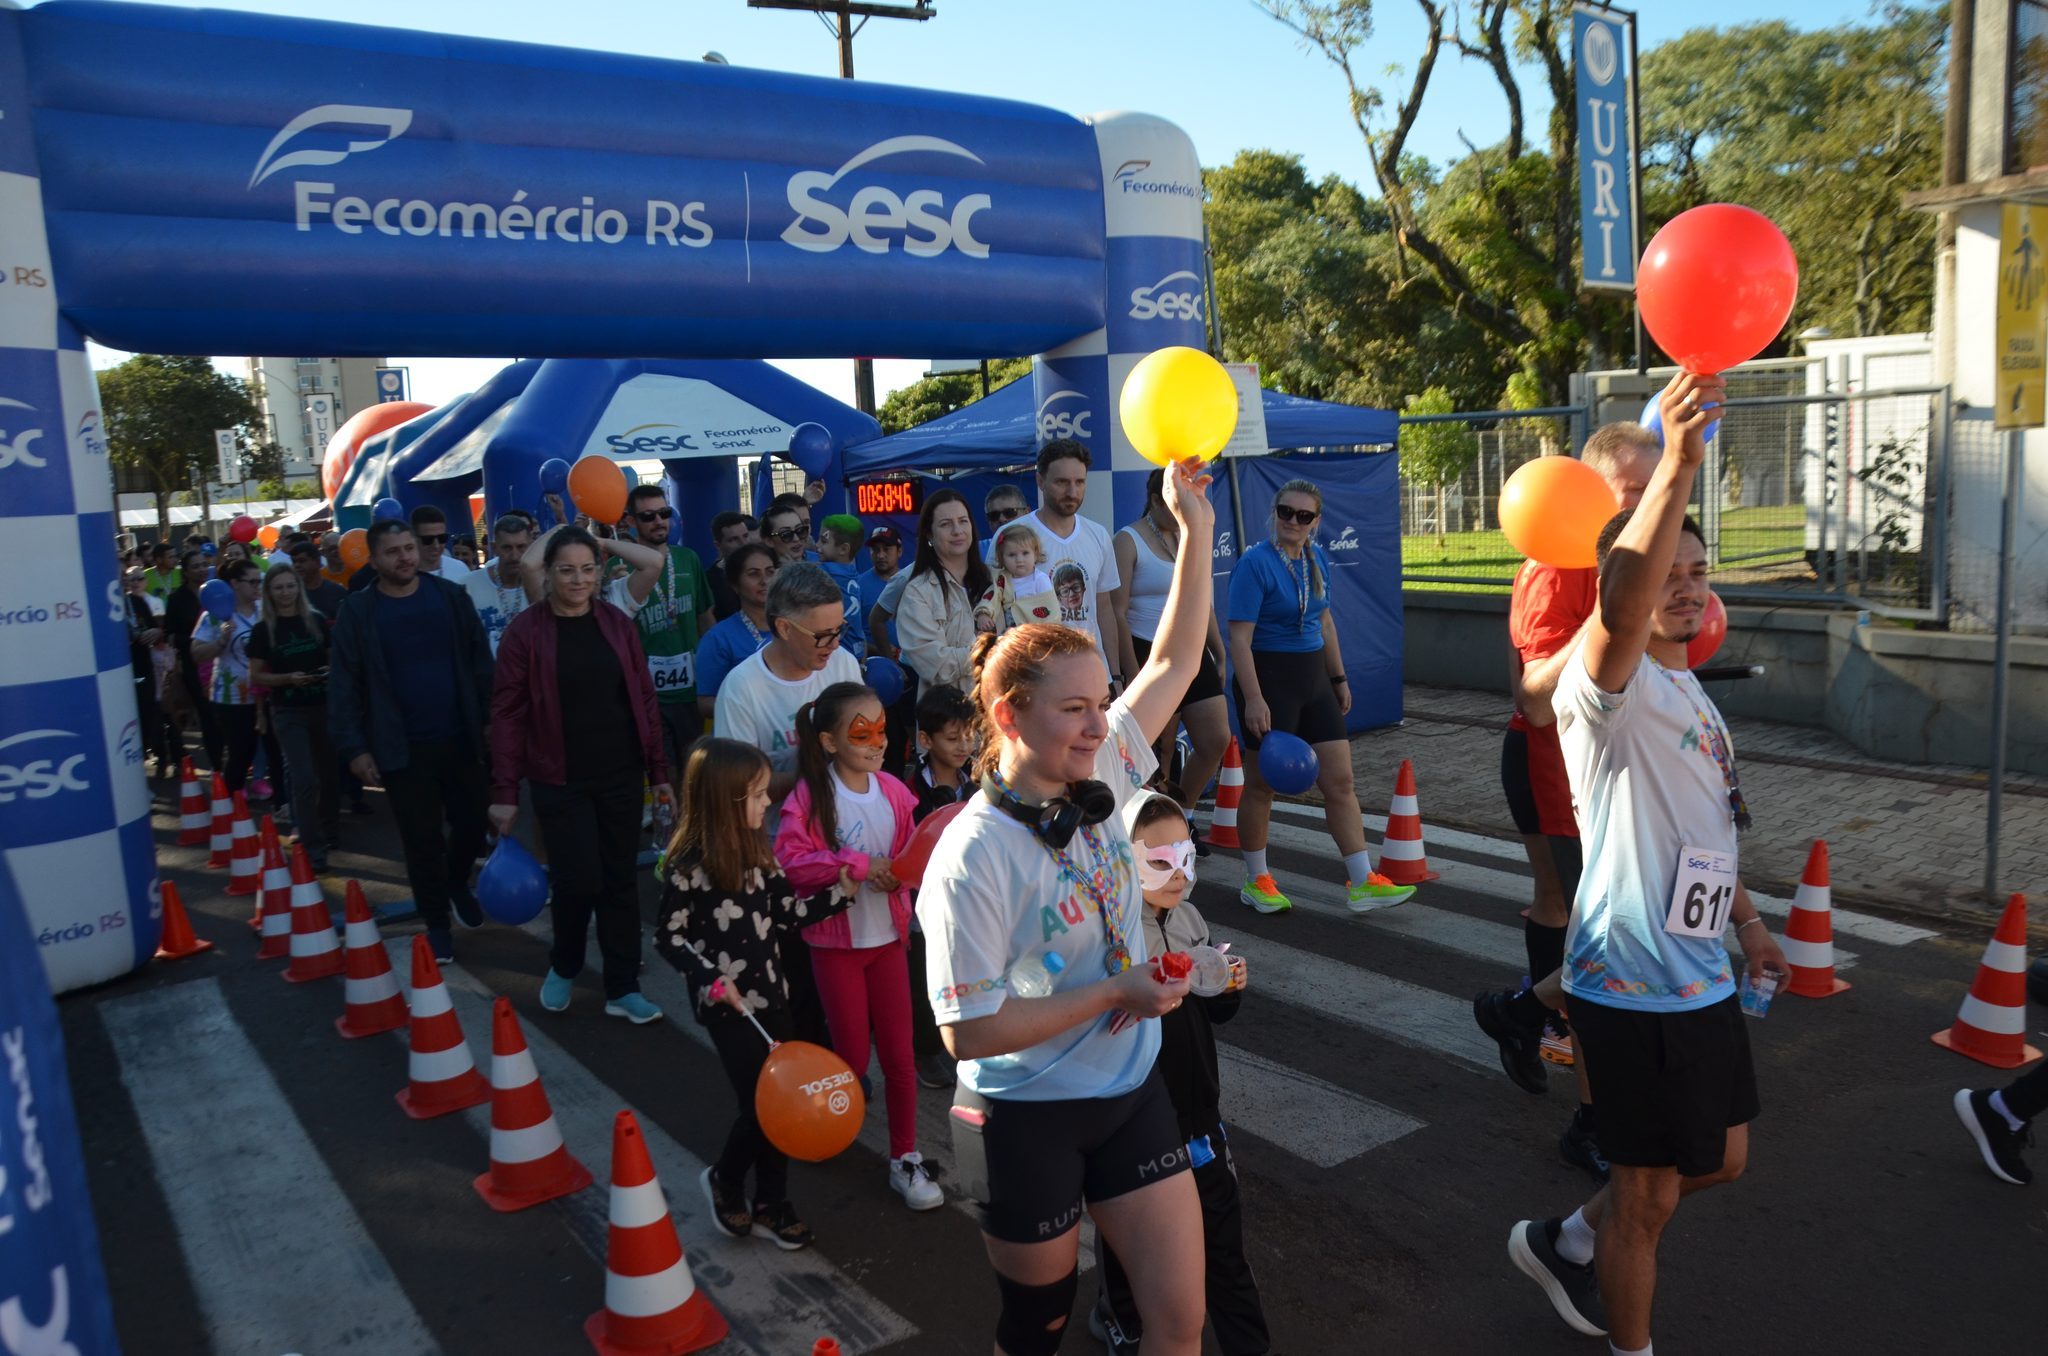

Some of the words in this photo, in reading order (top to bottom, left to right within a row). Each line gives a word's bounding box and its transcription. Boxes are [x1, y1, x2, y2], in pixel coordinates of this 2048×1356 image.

[1588, 97, 1620, 277] URI
[294, 180, 629, 244] Fecomércio
[646, 199, 714, 248] RS
[780, 170, 992, 260] Sesc
[14, 266, 48, 288] RS
[606, 434, 700, 454] Sesc
[704, 424, 782, 440] Fecomércio
[858, 482, 913, 513] 00:58:46
[55, 600, 84, 622] RS
[654, 666, 690, 689] 644
[37, 922, 94, 946] ércio
[99, 911, 127, 933] RS
[798, 1070, 855, 1096] CRESOL
